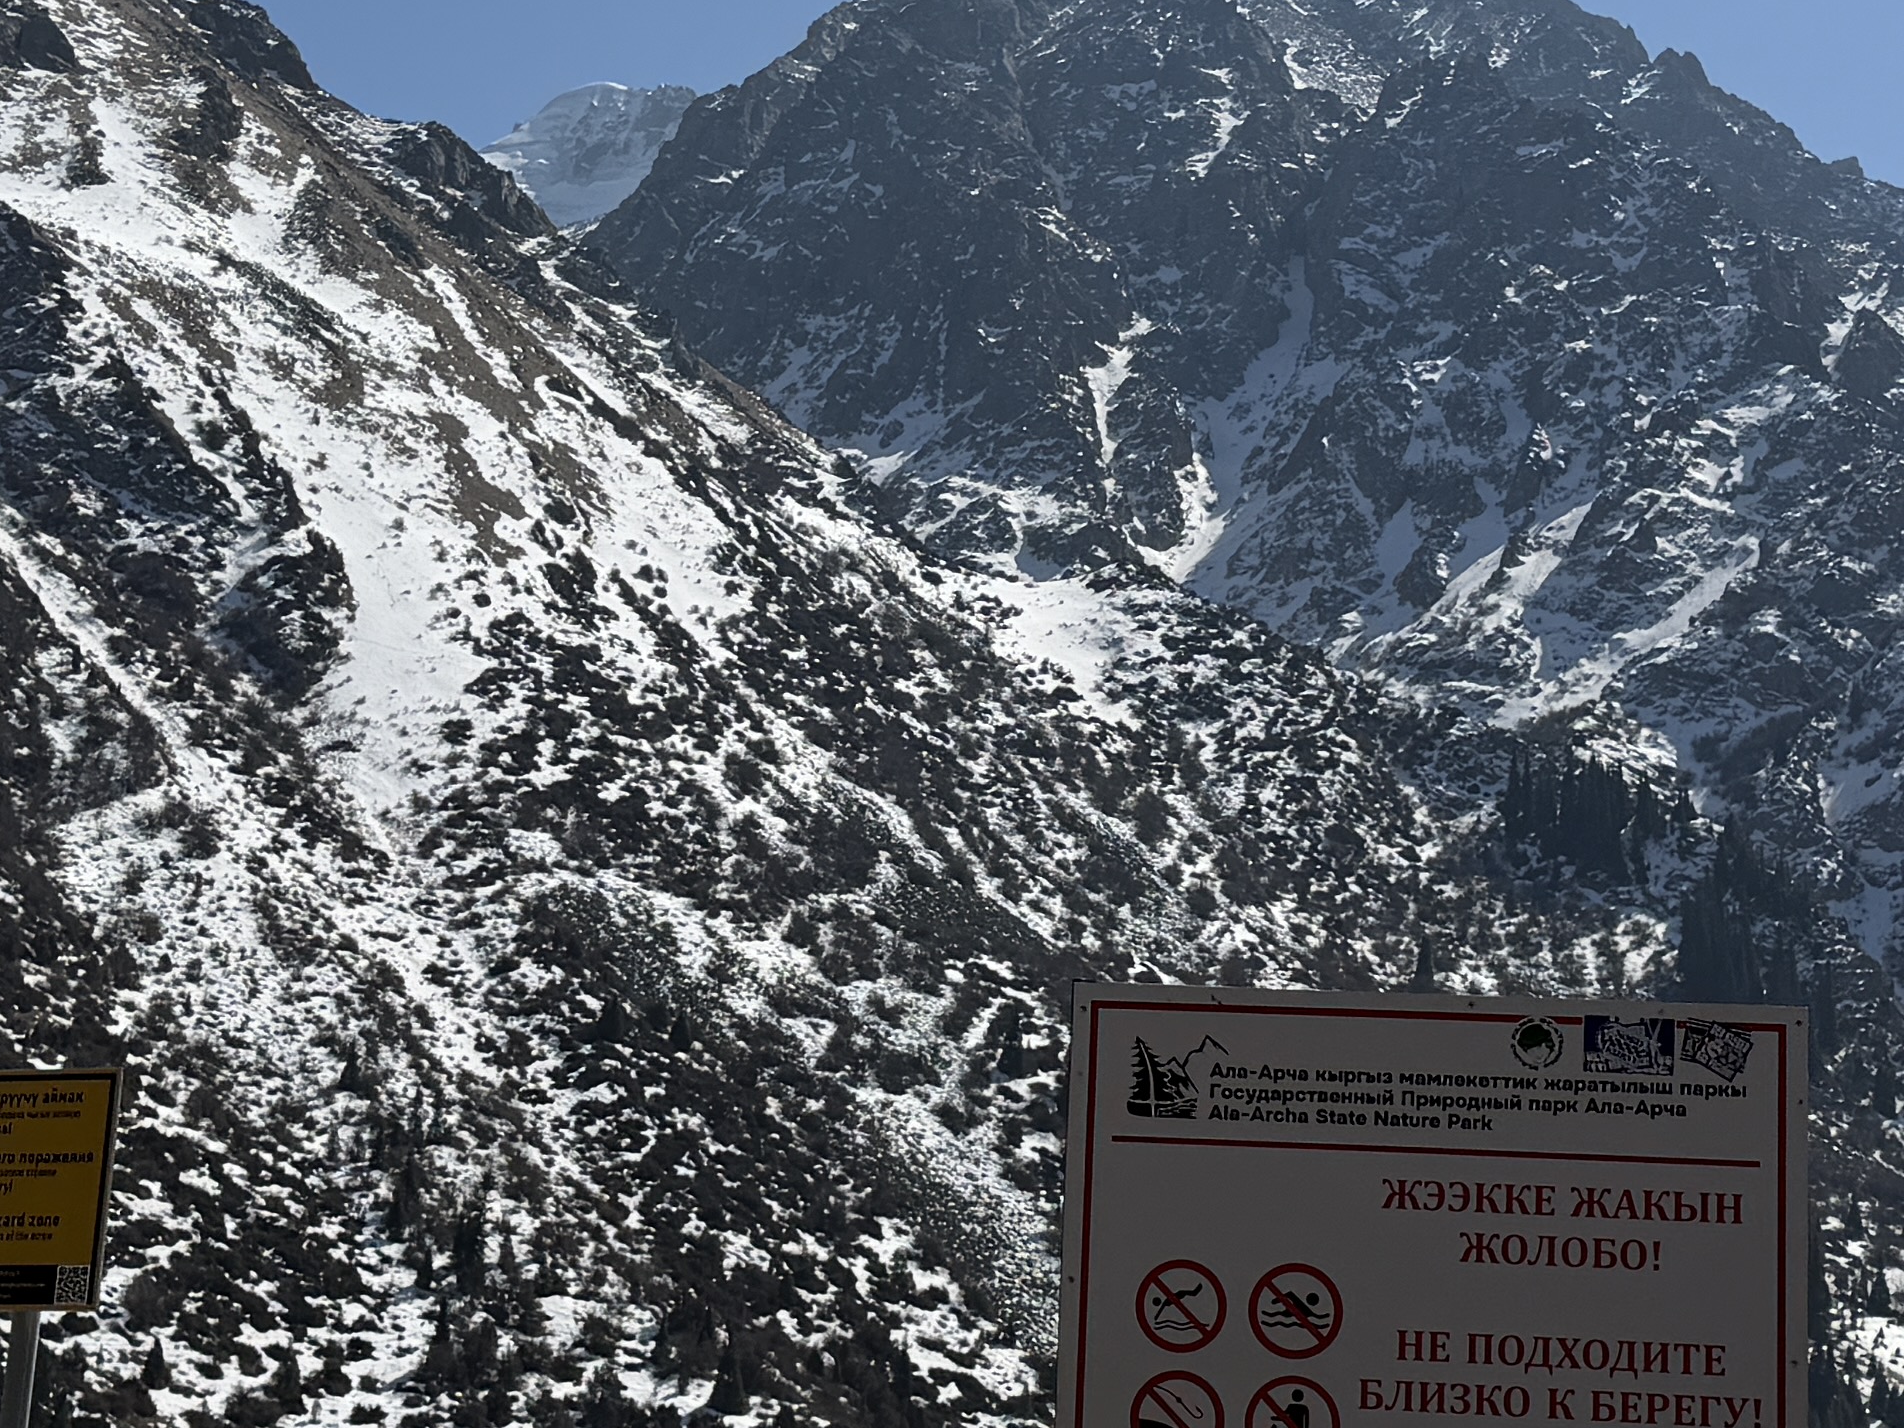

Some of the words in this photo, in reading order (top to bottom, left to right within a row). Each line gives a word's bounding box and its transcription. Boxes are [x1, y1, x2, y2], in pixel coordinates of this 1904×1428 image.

[42, 1087, 84, 1104] аймак
[1209, 1062, 1308, 1083] Ала-Арча
[1316, 1069, 1393, 1087] кыргыз
[1544, 1079, 1672, 1096] жаратылыш
[1680, 1083, 1747, 1100] паркы
[1208, 1105, 1309, 1124] Ala-Archa
[1315, 1109, 1367, 1126] State
[1374, 1111, 1441, 1129] Nature
[1447, 1113, 1494, 1131] Park
[1209, 1083, 1394, 1106] Государственный
[1401, 1090, 1521, 1112] Природный
[1528, 1098, 1578, 1116] парк
[1585, 1098, 1687, 1120] Ала-Арча
[19, 1151, 94, 1168] поражения
[1381, 1177, 1556, 1218] ЖЭЭККЕ
[1570, 1184, 1744, 1225] ЖАКЫН
[28, 1215, 61, 1228] zone
[1459, 1232, 1662, 1272] ЖОЛОБО!
[1396, 1329, 1450, 1364] НЕ
[1466, 1333, 1727, 1380] ПОДХОДИТЕ
[1358, 1378, 1531, 1419] БЛИЗКО
[1548, 1387, 1574, 1422] К
